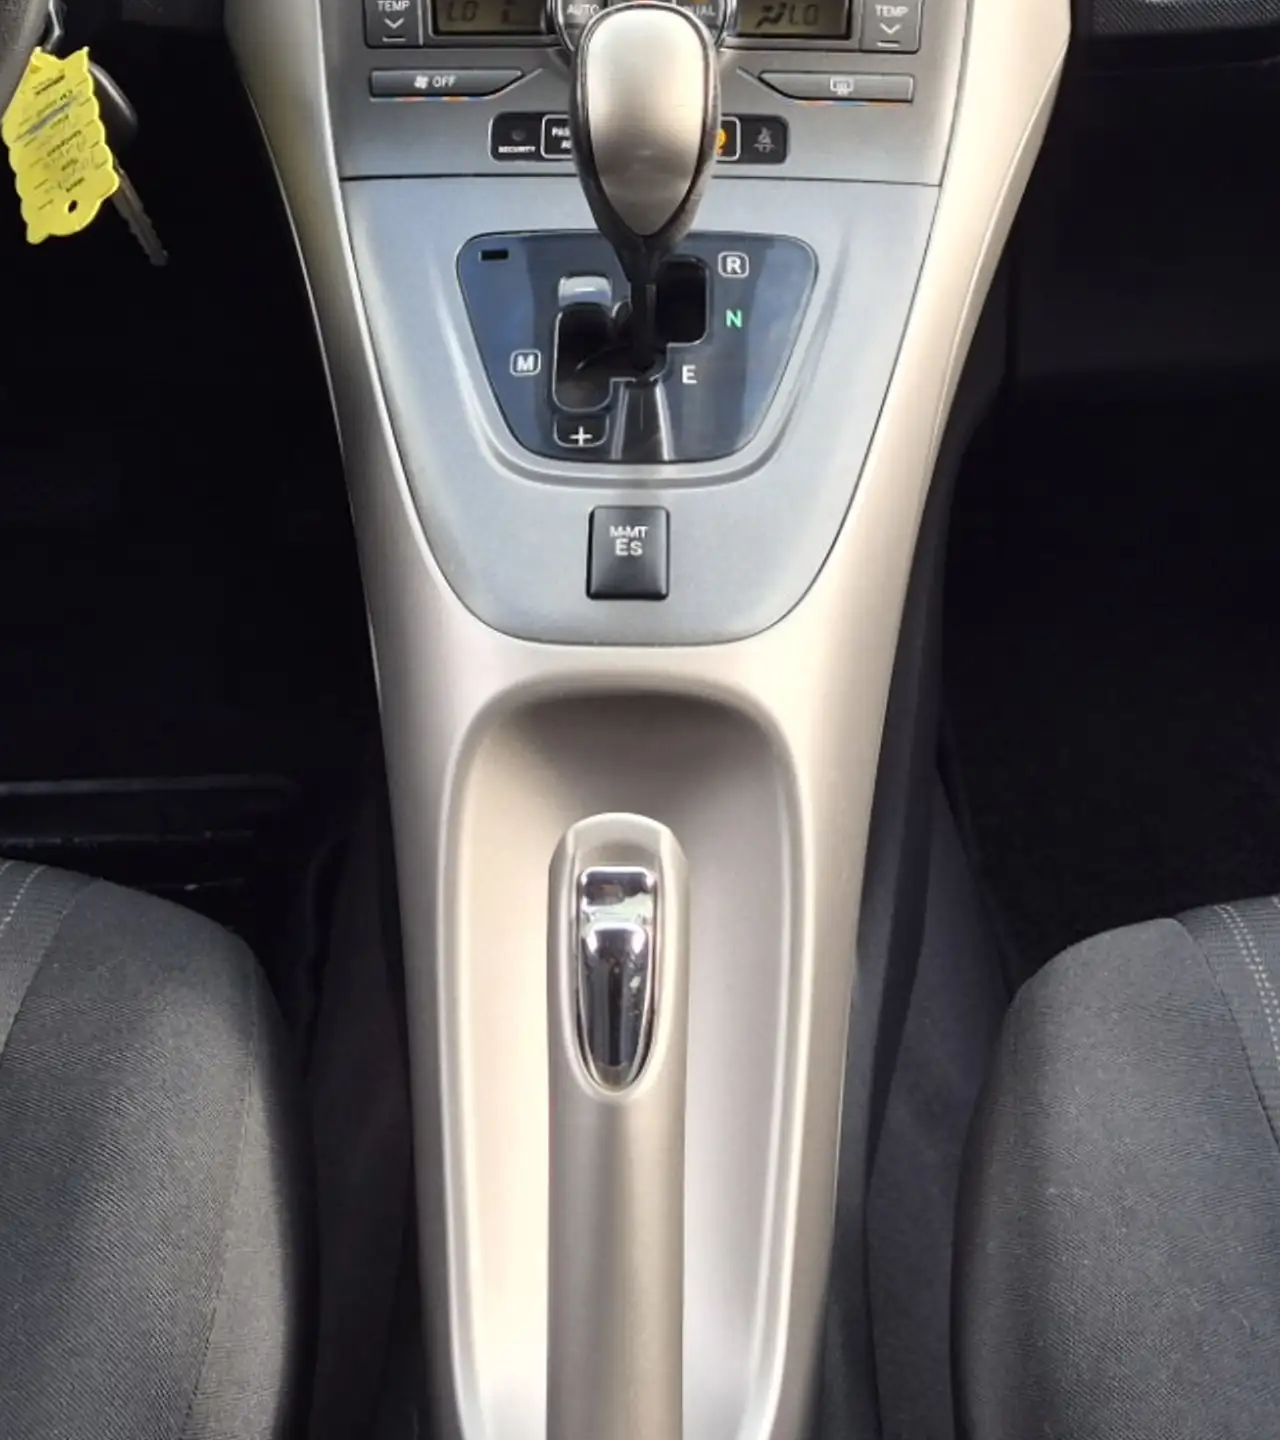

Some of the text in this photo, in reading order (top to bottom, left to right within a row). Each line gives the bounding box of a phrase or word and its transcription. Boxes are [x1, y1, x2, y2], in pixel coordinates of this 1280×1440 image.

[376, 0, 410, 13] TEMP
[875, 5, 909, 18] TEMP
[433, 75, 456, 88] OFF
[726, 255, 742, 273] R
[726, 310, 742, 328] N
[518, 354, 534, 372] M
[682, 366, 697, 384] E
